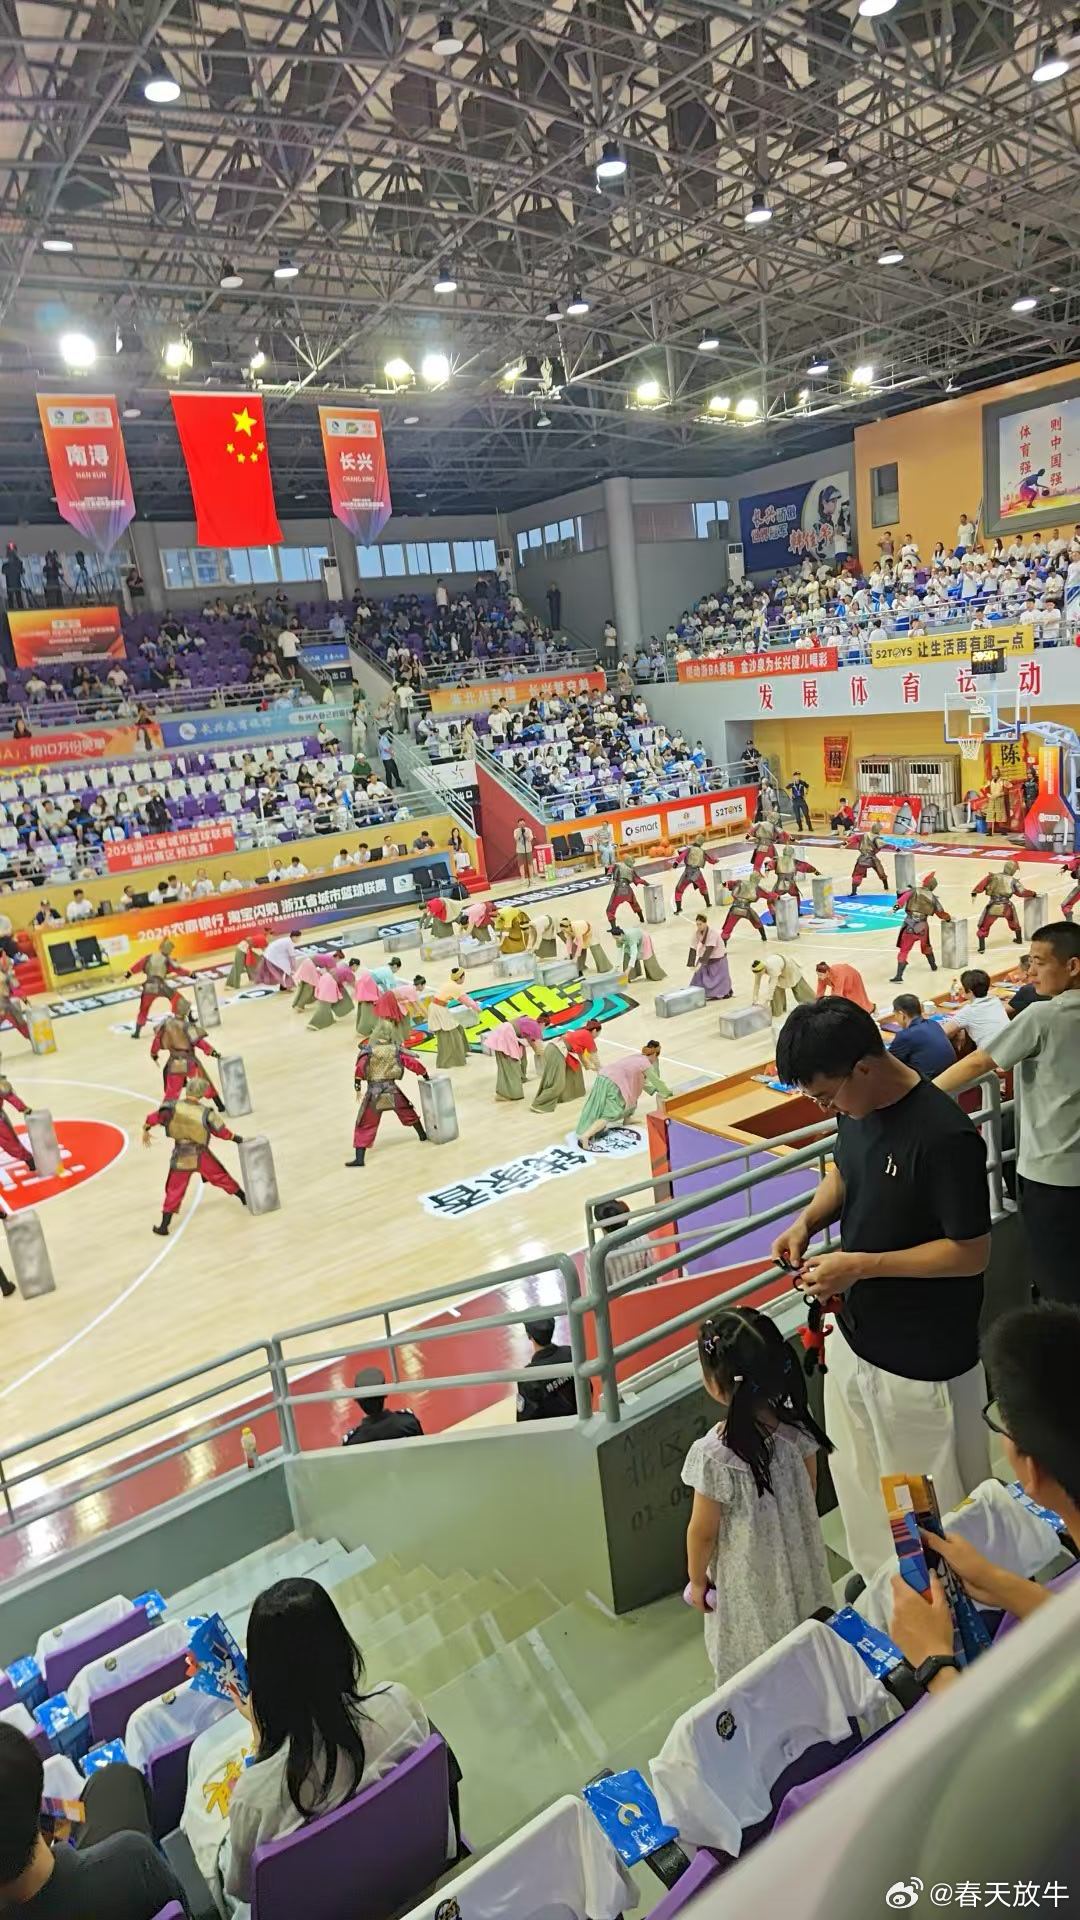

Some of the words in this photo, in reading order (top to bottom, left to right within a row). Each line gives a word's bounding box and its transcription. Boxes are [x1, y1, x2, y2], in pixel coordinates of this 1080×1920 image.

[65, 444, 109, 467] 南浔
[340, 451, 373, 471] 长兴
[1019, 424, 1032, 475] 体育强
[1050, 416, 1062, 486] 则中国强
[917, 631, 1024, 659] 让生活再有趣一点
[759, 661, 1041, 710] 发展体育运动
[1000, 743, 1020, 766] 陈
[715, 804, 743, 817] 52TOYS
[635, 822, 659, 834] smart
[281, 878, 387, 913] 浙江省城市篮球联赛
[257, 914, 273, 926] CITY
[274, 909, 313, 923] BASKETBALL
[314, 902, 338, 914] LEAGUE
